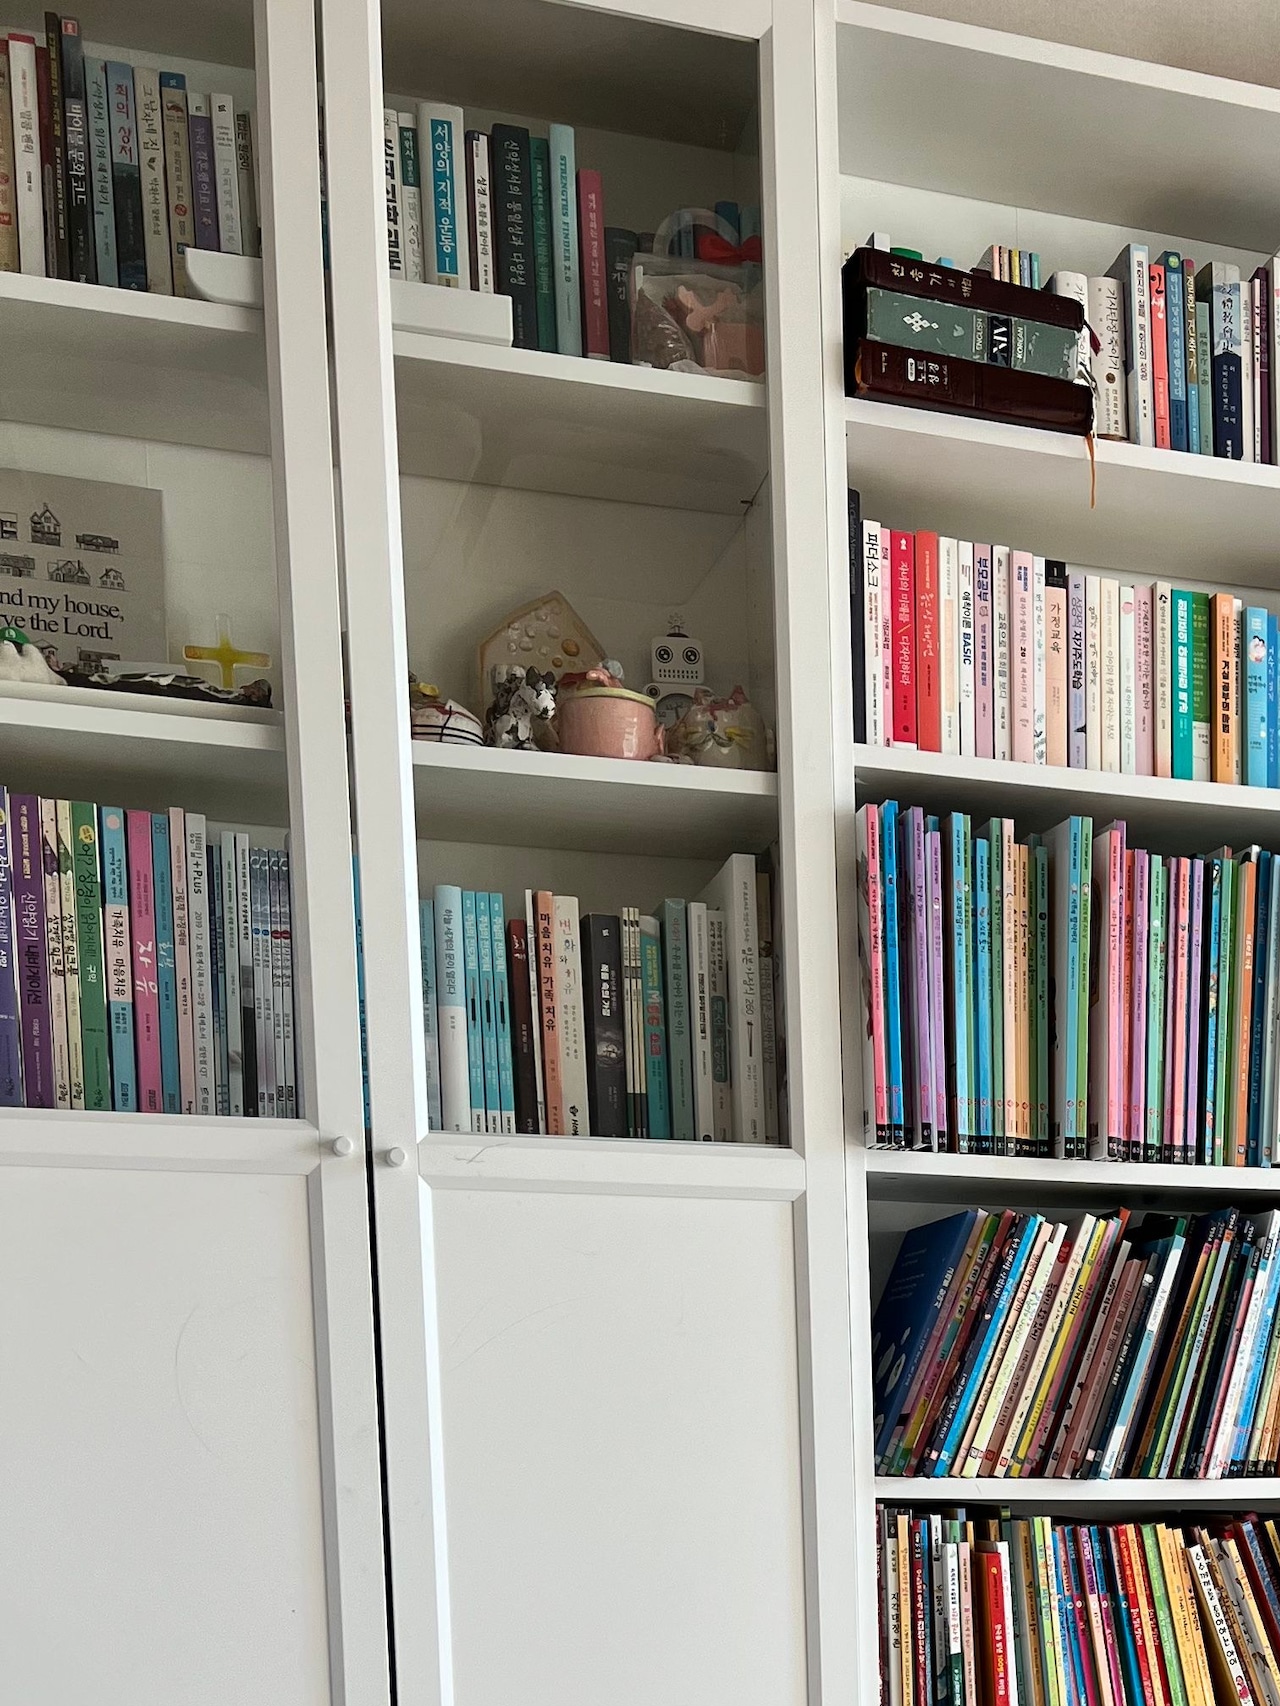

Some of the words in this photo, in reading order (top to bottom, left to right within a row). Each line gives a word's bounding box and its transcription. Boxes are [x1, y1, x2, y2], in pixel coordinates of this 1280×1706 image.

[65, 103, 83, 146] 바이블
[68, 149, 85, 178] 문화
[435, 123, 449, 176] 서양의
[504, 139, 524, 195] 신약성서의
[71, 178, 87, 207] 코드
[437, 179, 451, 214] 지적
[559, 154, 569, 217] STRENGTHS
[438, 216, 455, 253] 운동
[506, 200, 525, 246] 통일성과
[561, 220, 571, 262] FINDER
[509, 252, 527, 287] 다양성
[1105, 287, 1120, 333] 기사단장
[975, 318, 983, 351] ENGLISH
[992, 325, 1008, 354] NIV
[1016, 326, 1024, 359] KOREAN
[928, 362, 940, 385] 성경
[866, 532, 880, 588] 파더쇼크
[0, 588, 24, 606] nd
[27, 594, 61, 613] my
[64, 595, 125, 622] house,
[961, 591, 972, 630] 애착이론
[30, 613, 59, 633] the
[63, 618, 113, 641] Lord.
[962, 632, 972, 666] BASIC
[1072, 630, 1085, 690] 자기주도학습
[75, 842, 92, 865] 어?
[22, 891, 39, 942] 신약읽기
[111, 909, 125, 948] 가족치유
[24, 944, 42, 1005] 내비게이션
[113, 957, 127, 997] 마음치유
[745, 998, 756, 1015] 260
